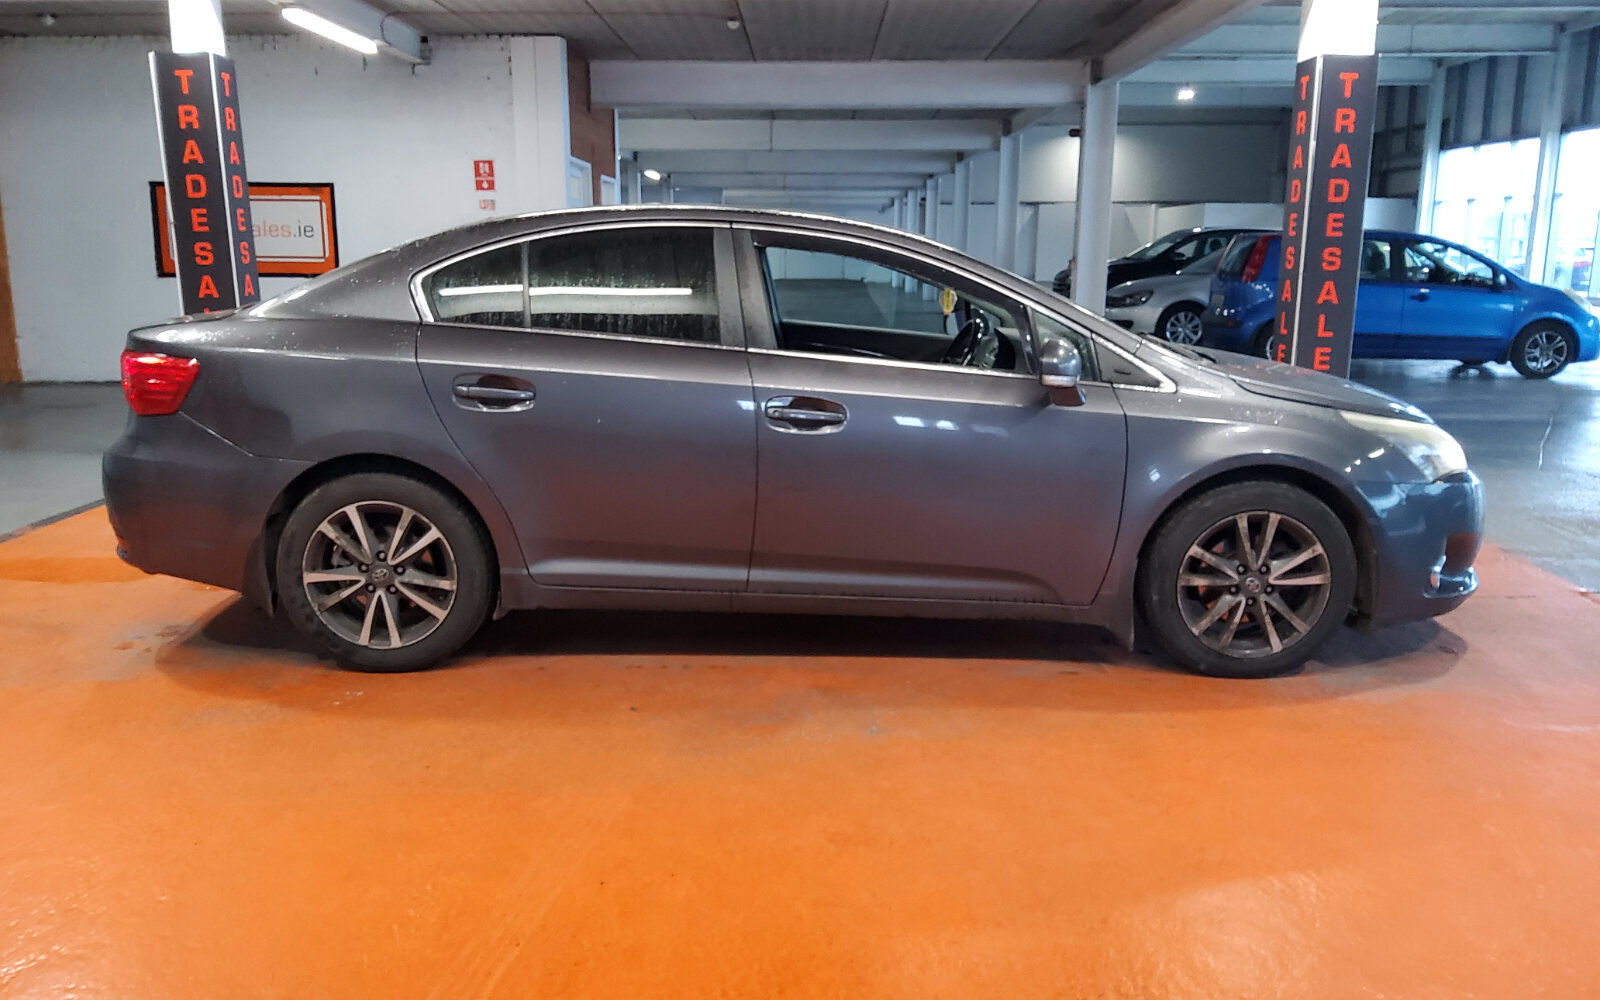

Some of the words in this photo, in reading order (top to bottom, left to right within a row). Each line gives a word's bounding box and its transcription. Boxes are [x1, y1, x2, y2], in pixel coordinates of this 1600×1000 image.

[174, 69, 219, 313] TRADESA
[221, 72, 255, 297] TRADESA
[1277, 75, 1309, 363] TRADESALE
[1314, 72, 1359, 371] TRADESALE
